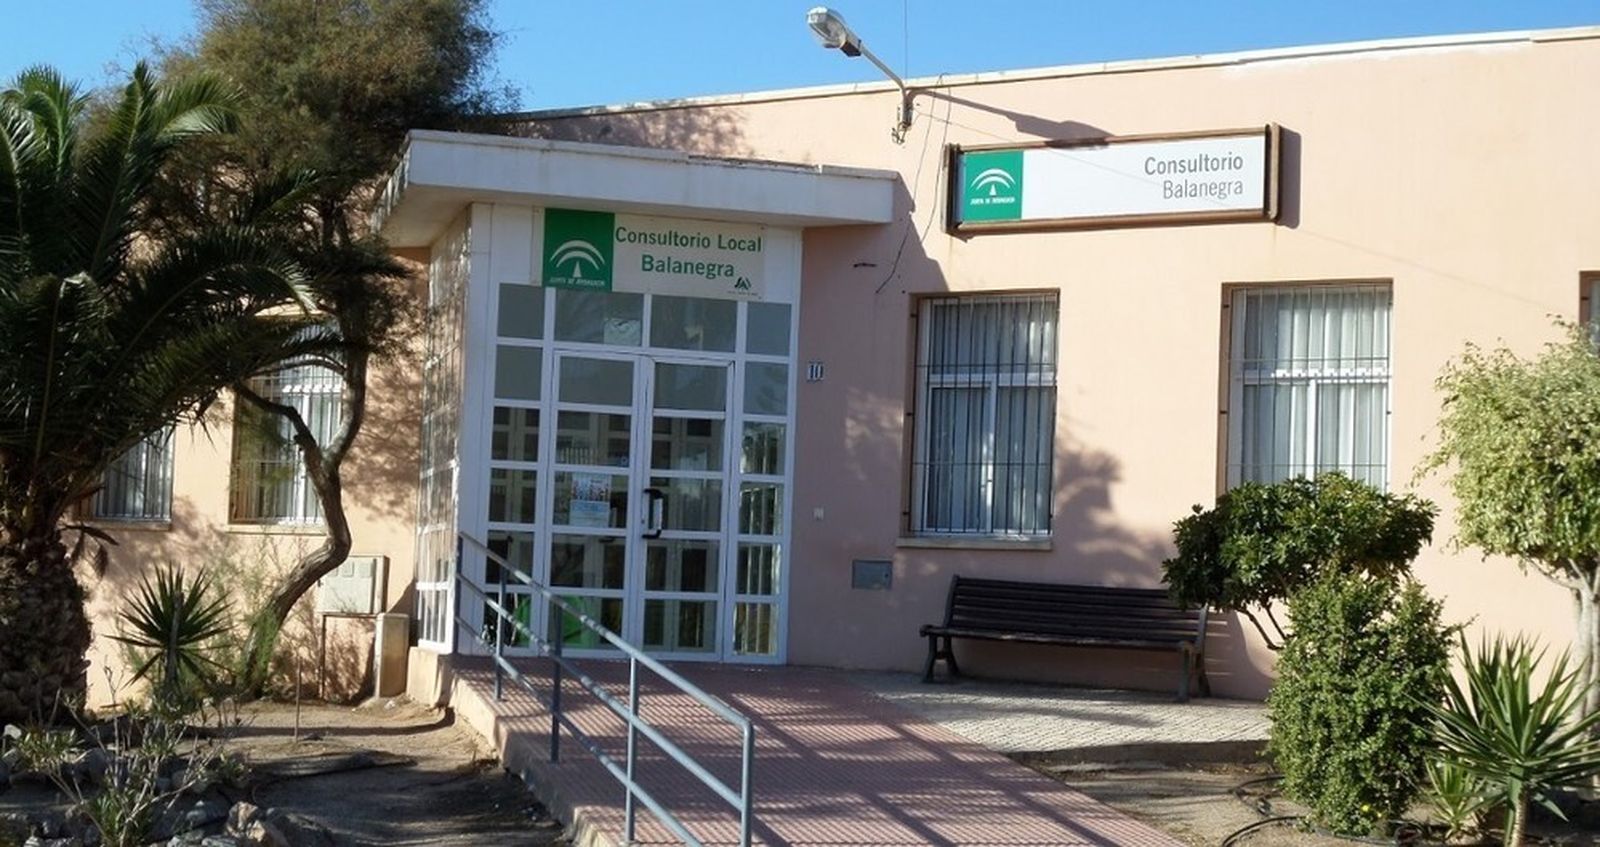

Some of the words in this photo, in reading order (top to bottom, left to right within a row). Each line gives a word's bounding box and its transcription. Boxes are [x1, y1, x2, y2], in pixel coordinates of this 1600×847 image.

[1144, 151, 1243, 176] Consultorio
[1163, 179, 1243, 200] Balanegra
[615, 226, 711, 249] Consultorio
[717, 234, 762, 252] Local
[641, 254, 735, 280] Balanegra
